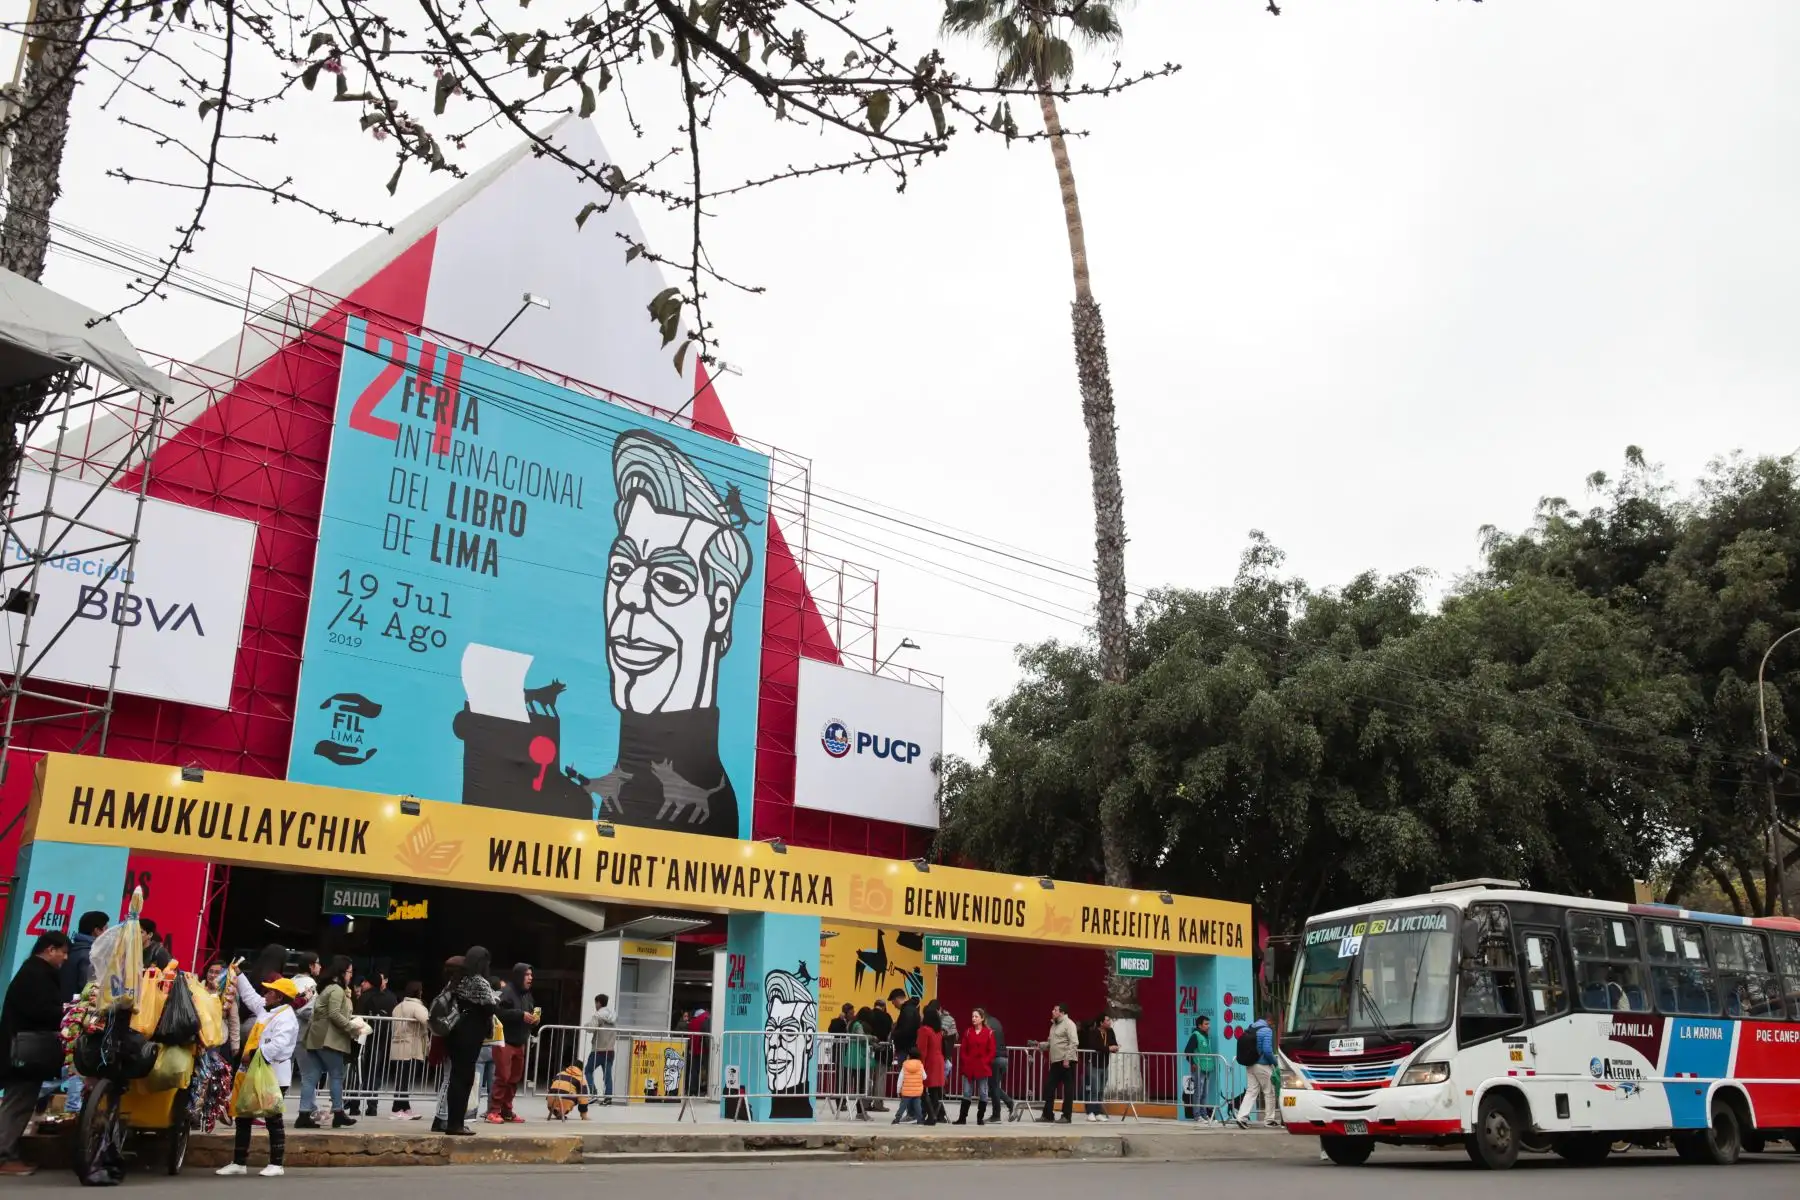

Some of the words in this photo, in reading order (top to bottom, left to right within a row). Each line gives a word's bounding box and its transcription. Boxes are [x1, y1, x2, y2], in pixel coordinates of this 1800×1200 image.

[349, 321, 464, 456] 24
[401, 375, 479, 435] FERIA
[395, 423, 584, 510] INTERNACIONAL
[388, 467, 428, 512] DEL
[446, 481, 527, 538] LIBRO
[383, 513, 415, 556] DE
[430, 523, 499, 578] LIMA
[76, 584, 204, 637] BBVA
[337, 569, 379, 600] 19
[392, 581, 452, 619] Jul
[327, 597, 369, 631] /4
[381, 612, 447, 653] Ago
[328, 631, 362, 648] 2019
[331, 730, 364, 745] LIMA
[332, 711, 365, 734] FIL
[857, 731, 922, 764] PUCP
[68, 786, 371, 855] HAMUKULLAYCHIK
[488, 837, 582, 881] WALIKI
[595, 850, 834, 906] PURT'ANIWAPXTAXA
[25, 890, 76, 937] 24
[333, 890, 380, 909] SALIDA
[904, 886, 1026, 928] BIENVENIDOS
[931, 939, 960, 948] ENTRADA
[1081, 906, 1170, 941] PAREJEITYA
[1178, 917, 1244, 949] KAMETSA
[1304, 923, 1353, 946] VENTANILLA
[1386, 919, 1399, 933] LA
[1401, 914, 1447, 932] VICTORIA
[931, 954, 959, 962] INTERNET
[1120, 957, 1150, 971] INGRESO
[1680, 1026, 1691, 1039] LA
[1693, 1026, 1723, 1040] MARINA
